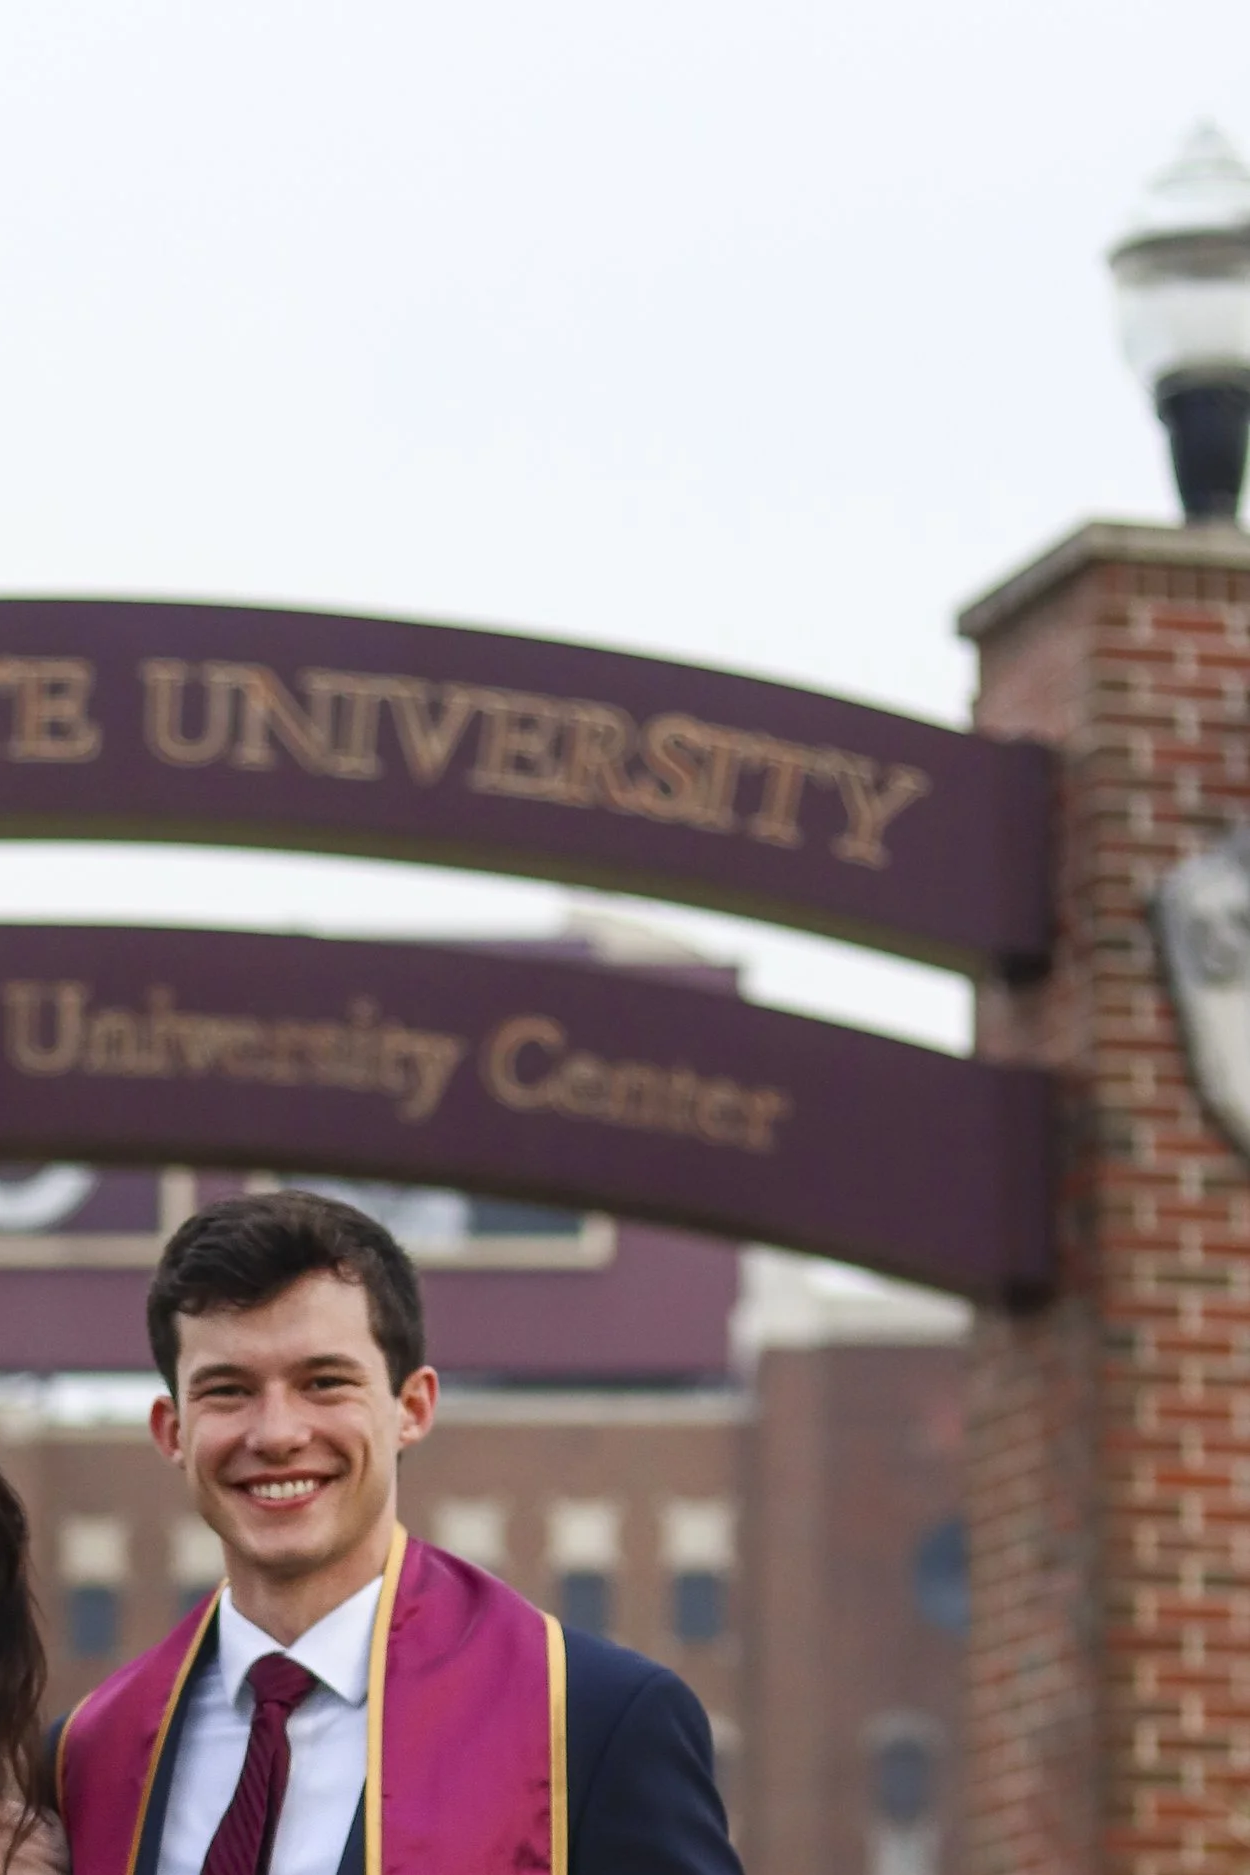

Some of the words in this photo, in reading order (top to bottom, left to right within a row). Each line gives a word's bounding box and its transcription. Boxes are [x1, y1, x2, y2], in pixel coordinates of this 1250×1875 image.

[140, 656, 930, 868] UNIVERSITY
[1, 980, 466, 1124] University
[481, 1015, 794, 1152] Center
